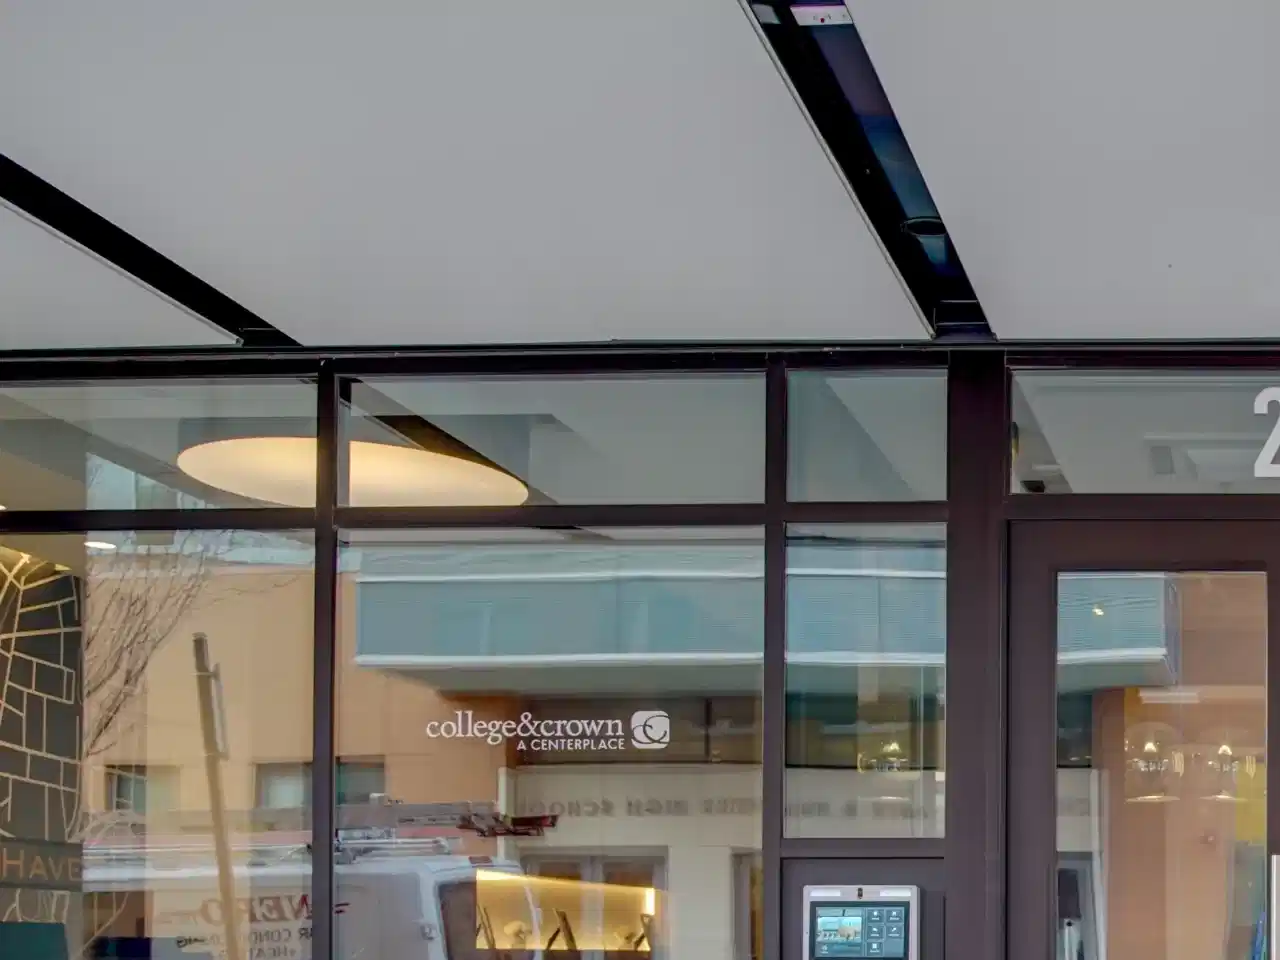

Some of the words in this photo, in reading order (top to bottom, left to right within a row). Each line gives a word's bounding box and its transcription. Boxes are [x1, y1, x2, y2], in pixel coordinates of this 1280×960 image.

[426, 710, 624, 746] college&crown
[517, 738, 527, 750] A
[530, 737, 626, 750] CENTERPLACE
